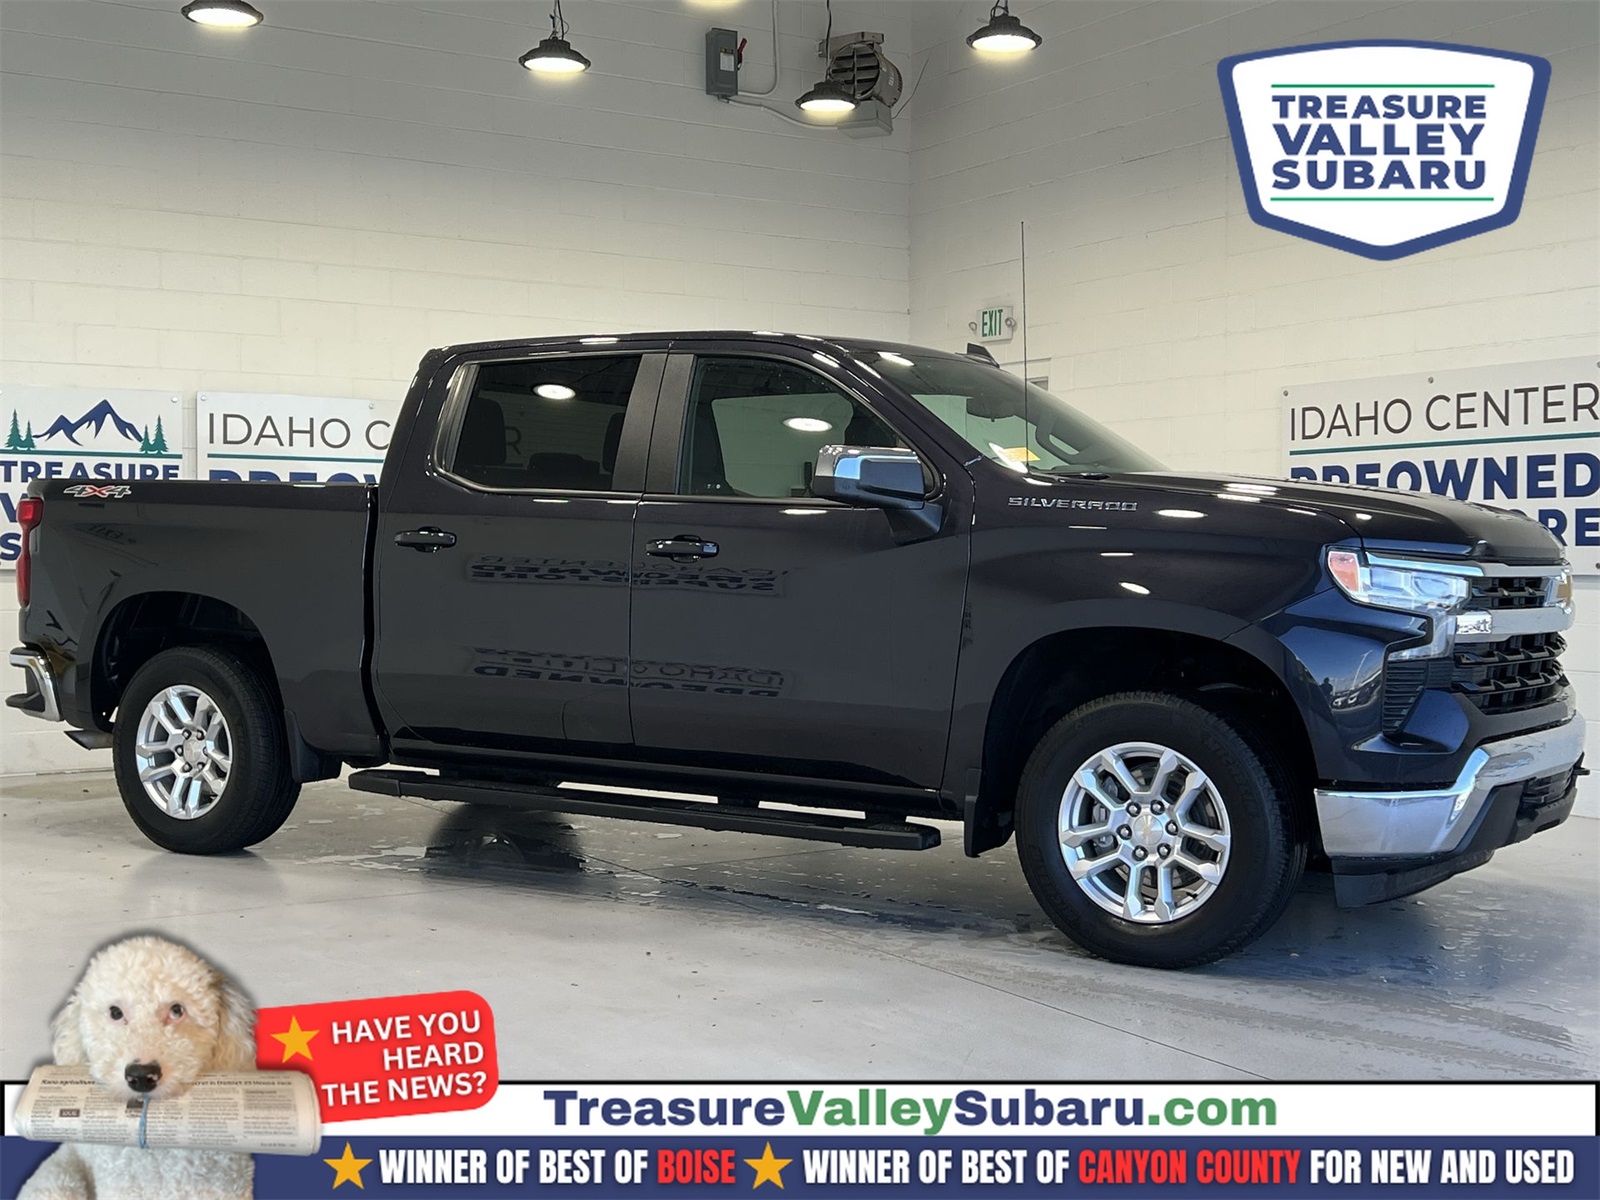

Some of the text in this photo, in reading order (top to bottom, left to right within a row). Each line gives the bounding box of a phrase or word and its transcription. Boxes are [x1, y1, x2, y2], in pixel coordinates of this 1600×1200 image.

[982, 309, 1003, 337] EXIT
[1290, 382, 1600, 441] IDAHO CENTER
[209, 412, 351, 448] IDAHO
[0, 461, 179, 482] TREASURE
[1008, 497, 1138, 511] SILVERADO
